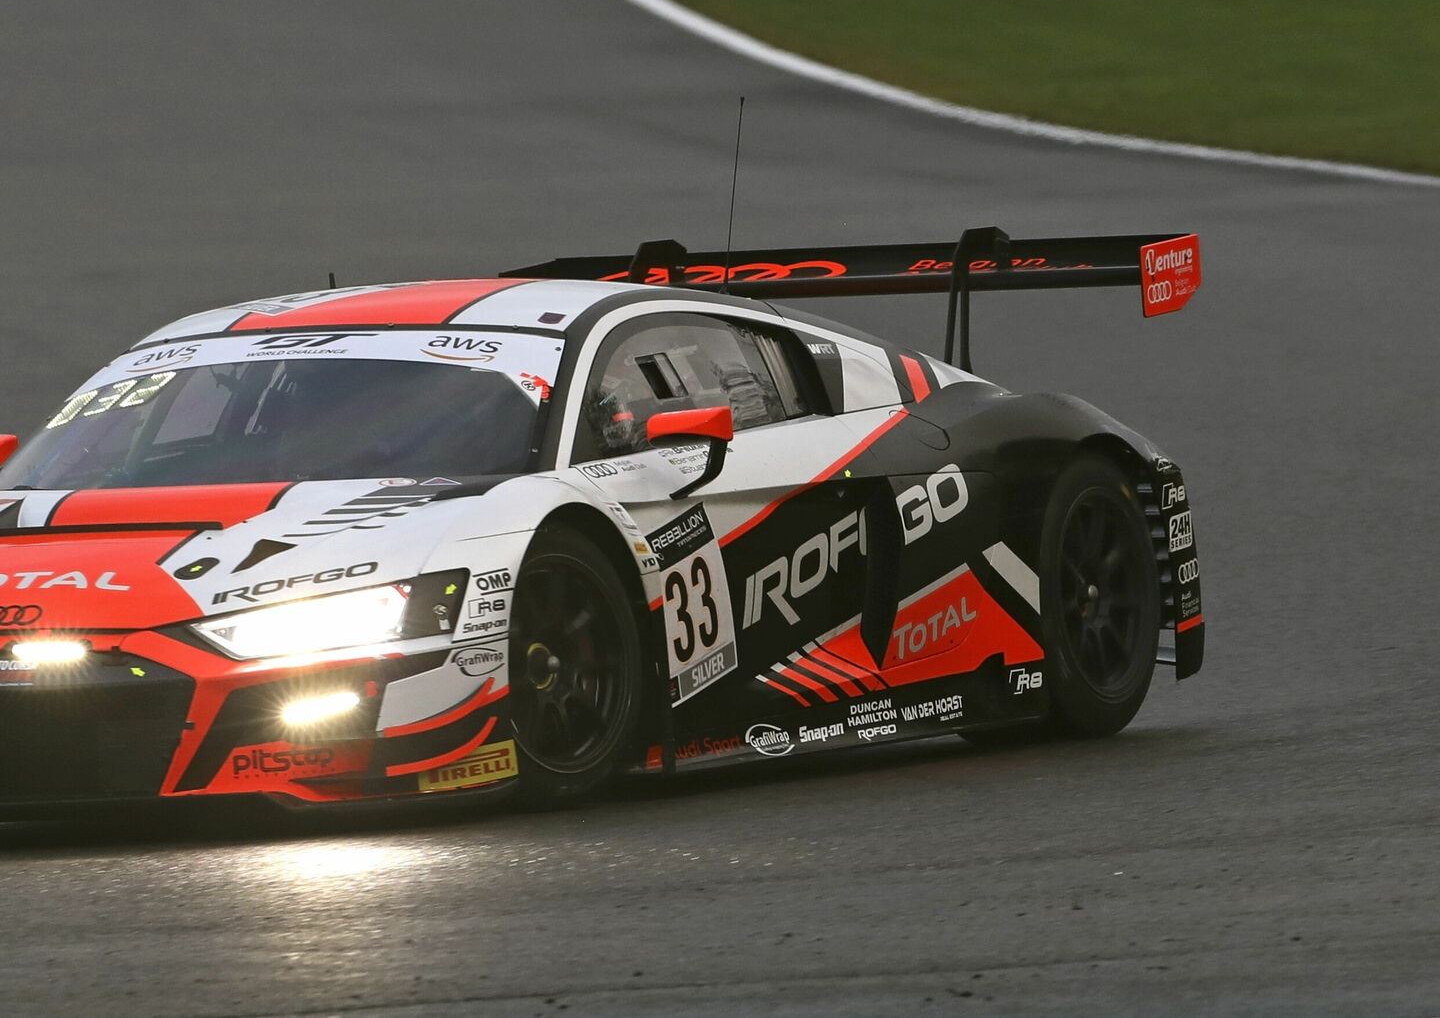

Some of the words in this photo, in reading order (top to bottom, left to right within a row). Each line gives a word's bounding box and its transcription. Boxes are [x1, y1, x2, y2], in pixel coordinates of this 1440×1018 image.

[251, 333, 379, 349] GT
[427, 335, 504, 355] aws
[808, 342, 836, 355] WRT
[133, 343, 202, 367] aws
[246, 349, 286, 358] WORLD
[286, 348, 349, 357] CHALLENGE
[1167, 485, 1186, 506] R8
[651, 511, 704, 553] REBELLION
[1170, 511, 1192, 539] 24H
[1170, 534, 1192, 550] SERIES
[475, 572, 512, 591] OMP
[478, 599, 506, 615] R8
[665, 554, 719, 664] 33
[462, 619, 508, 634] Snap-on
[893, 596, 977, 660] TOTAL
[691, 651, 725, 688] SILVER
[1016, 671, 1043, 691] R8
[850, 698, 892, 715] DUNCAN
[900, 704, 918, 722] VAN
[919, 701, 935, 718] DER
[935, 695, 963, 713] HORST
[847, 709, 898, 727] HAMILTON
[799, 723, 845, 743] Snap-on
[857, 724, 897, 741] ROFGO
[233, 747, 335, 776] pitstop
[428, 748, 511, 784] PIRELLI
